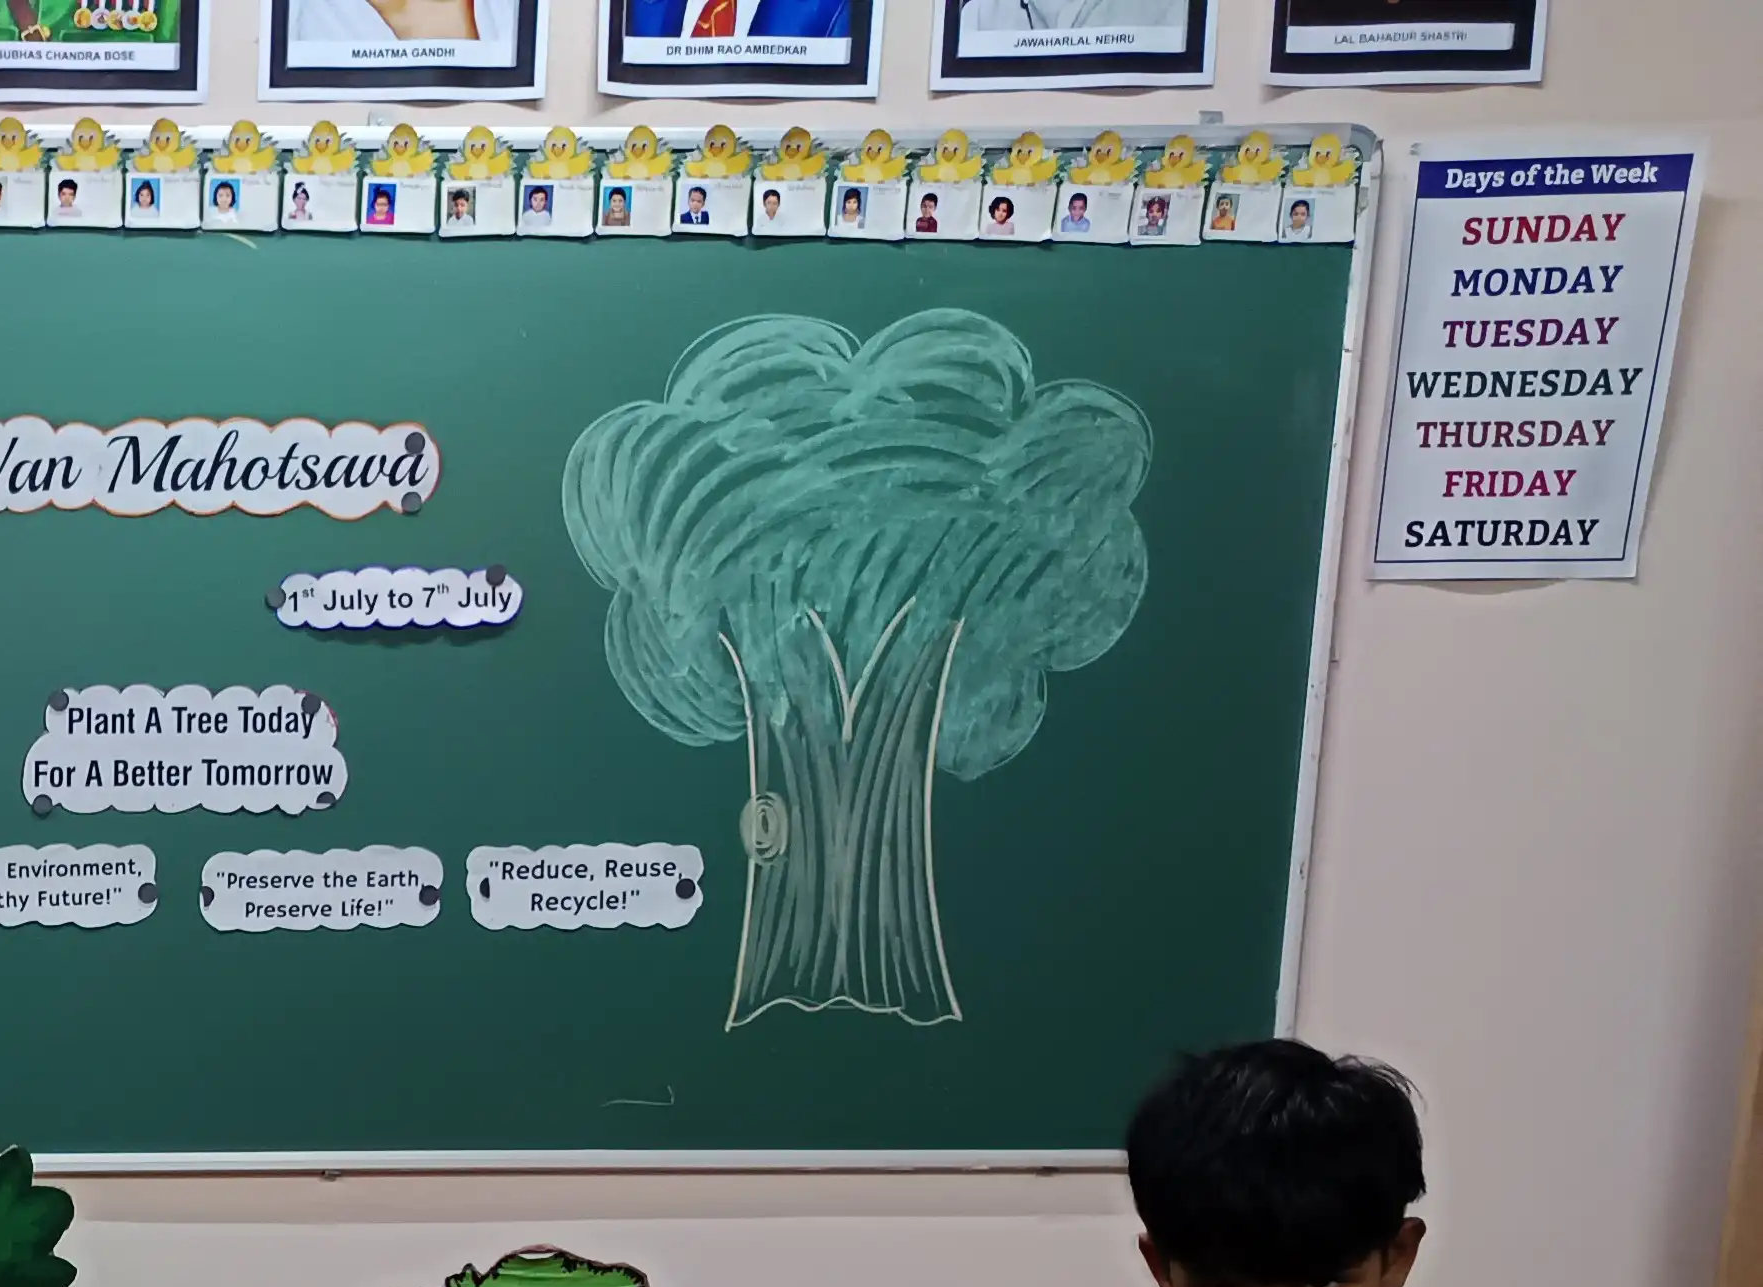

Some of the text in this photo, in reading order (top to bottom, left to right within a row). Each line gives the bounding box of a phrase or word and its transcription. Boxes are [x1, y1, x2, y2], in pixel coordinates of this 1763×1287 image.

[666, 44, 808, 56] DR BHIM RAO AMBEDKAR
[1013, 33, 1136, 49] JAWAHARLAL NEHRU
[1334, 34, 1356, 45] LAL
[1420, 28, 1469, 42] SHASTRI
[45, 49, 102, 61] CHANDRA
[104, 50, 136, 62] BOSE
[351, 47, 456, 60] MAHATMA GANDHI
[1444, 160, 1659, 194] Days of the Week
[1461, 212, 1627, 246] SUNDAY
[1449, 264, 1625, 298] MONDAY
[1441, 316, 1620, 349] TUESDAY
[1405, 367, 1644, 400] WEDNESDAY
[1415, 418, 1616, 450] THURSDAY
[1441, 468, 1577, 499] FRIDAY
[1404, 518, 1600, 549] SATURDAY
[287, 582, 513, 616] 1st July to 7th July
[67, 705, 318, 739] Plant A Tree Today
[33, 758, 334, 788] For A Better Tomorrow
[6, 857, 143, 880] Environment,
[215, 870, 315, 891] "Preserve
[322, 871, 358, 889] the
[488, 860, 596, 883] "Reduce,
[36, 886, 123, 908] Future!"
[244, 898, 395, 918] Preserve Life!"
[529, 890, 641, 915] Recycle!"
